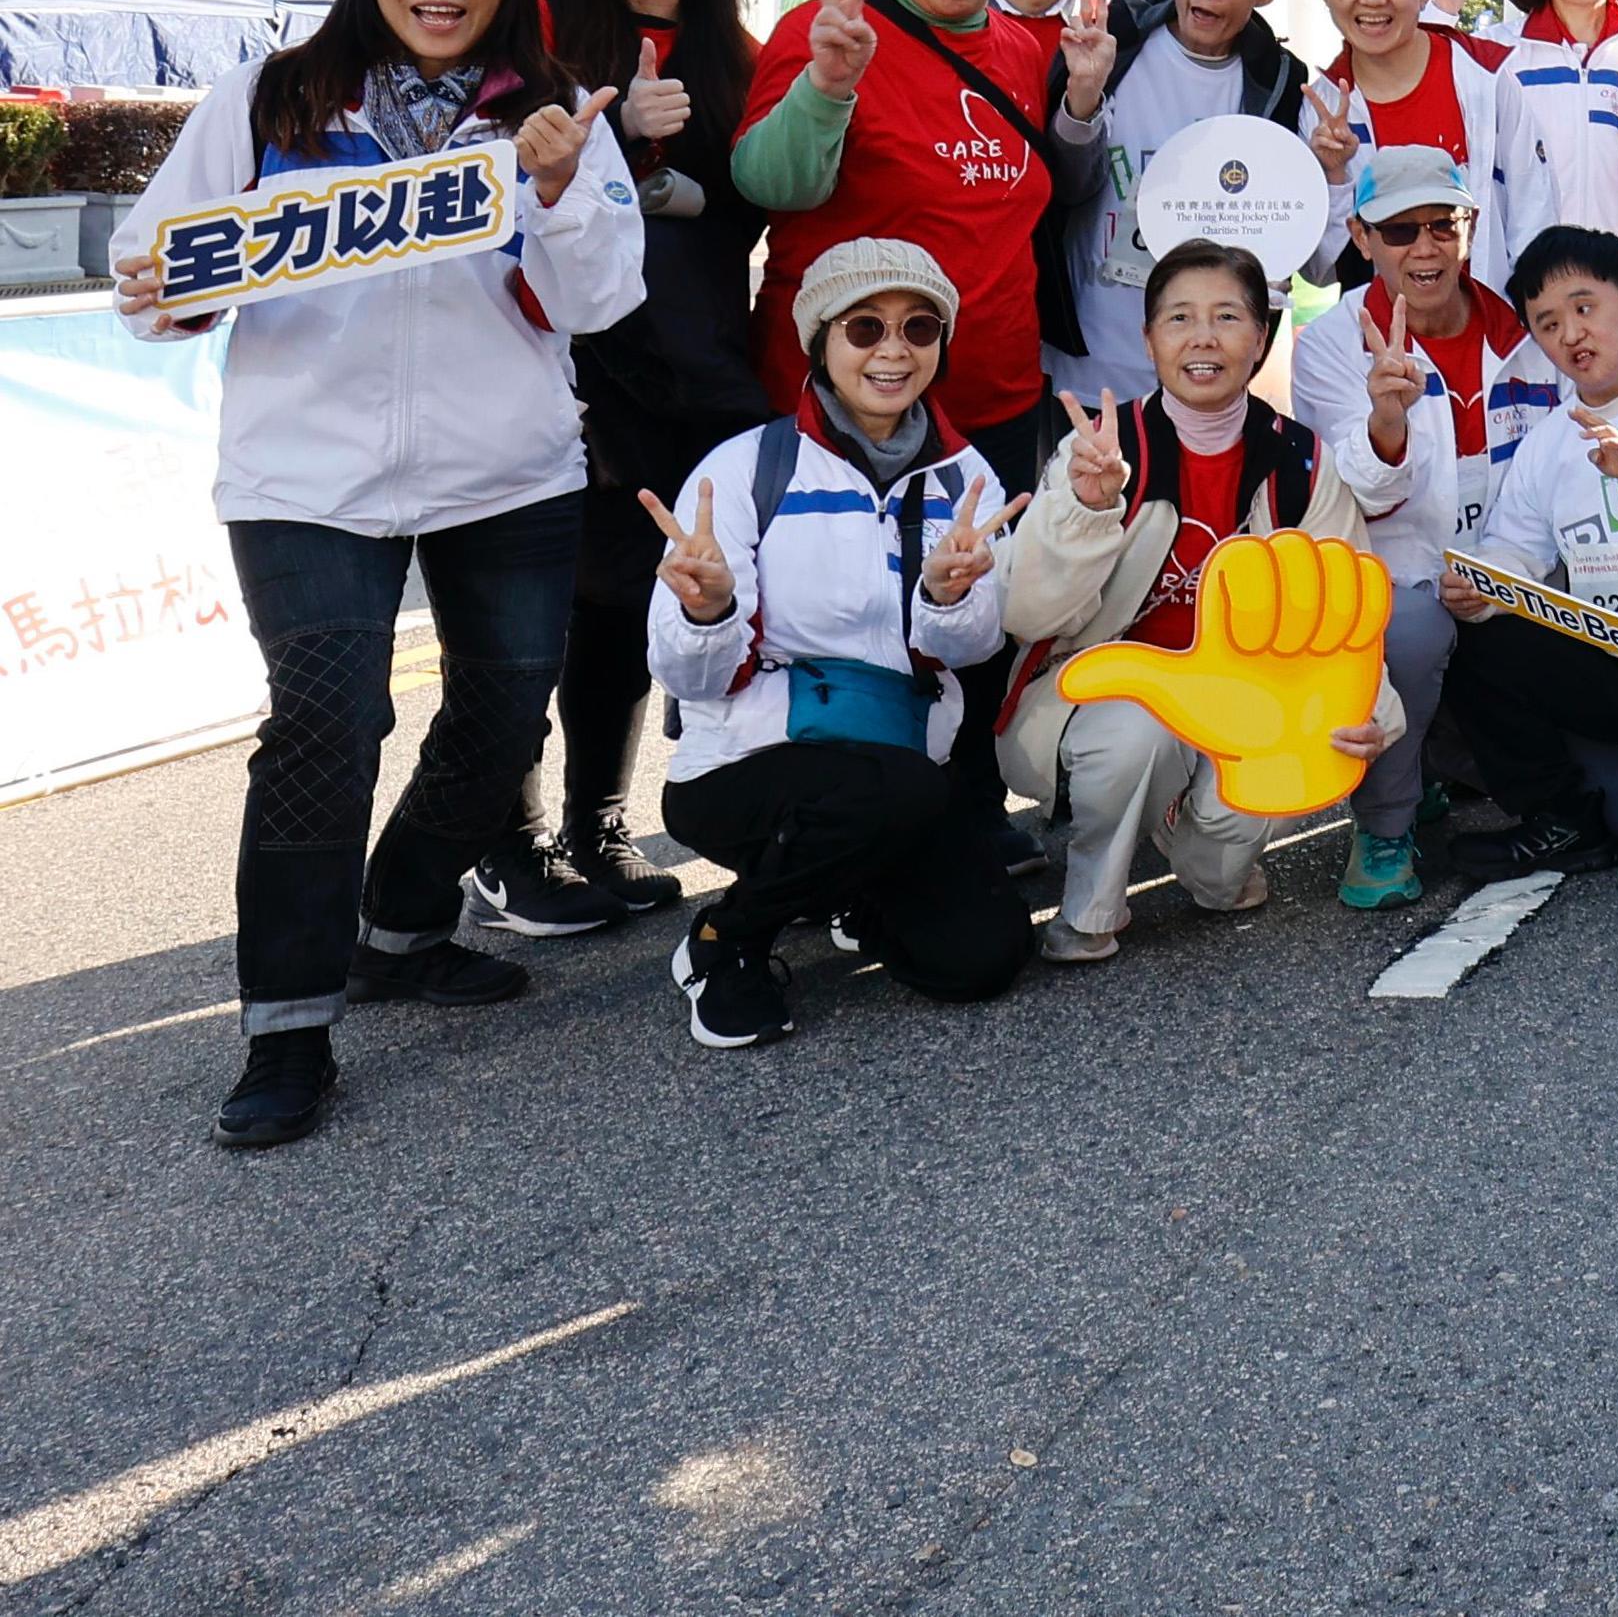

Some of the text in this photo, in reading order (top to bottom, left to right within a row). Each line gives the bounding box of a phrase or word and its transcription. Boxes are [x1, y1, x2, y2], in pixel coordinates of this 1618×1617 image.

[935, 138, 1003, 160] CARE
[162, 164, 493, 300] 全力以赴
[1176, 212, 1290, 224] The Hong Kong Jockey Club
[1202, 226, 1263, 235] Charities Trust
[2, 554, 228, 674] 馬拉松
[1453, 561, 1515, 605] #Be
[1514, 586, 1581, 632] The
